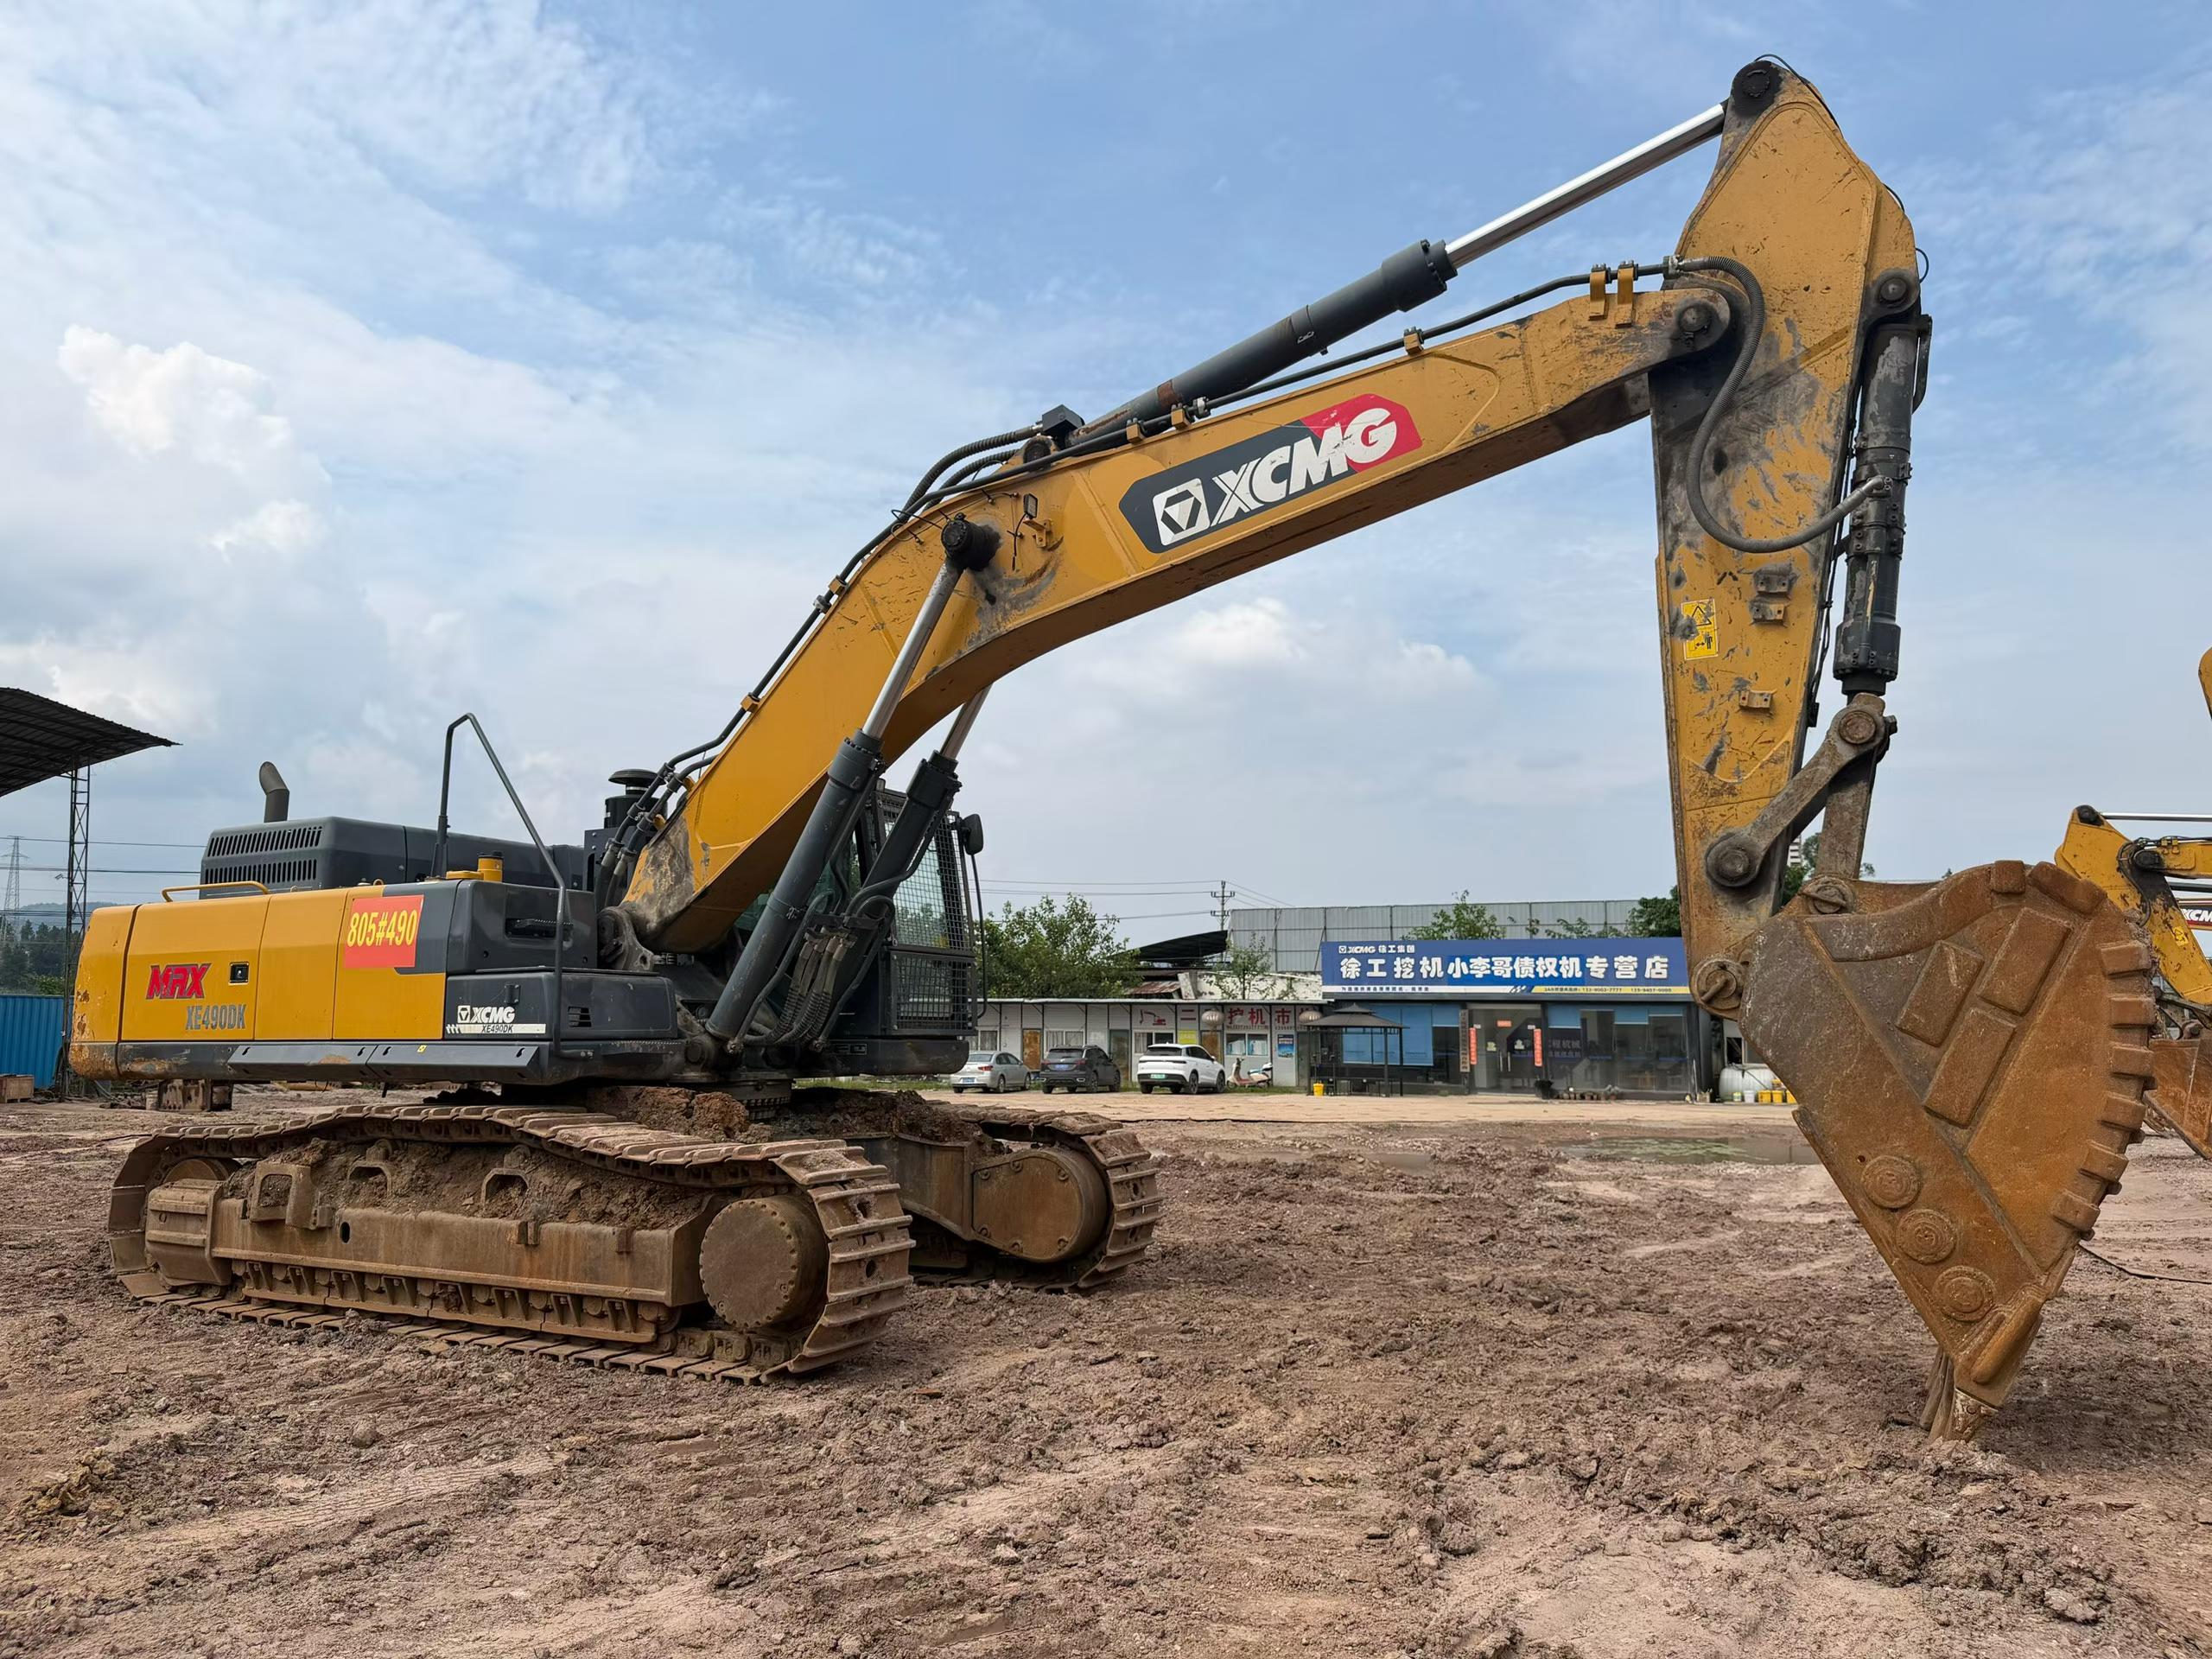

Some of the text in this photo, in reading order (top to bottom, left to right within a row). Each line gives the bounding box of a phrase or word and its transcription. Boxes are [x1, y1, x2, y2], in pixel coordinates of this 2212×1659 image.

[1210, 408, 1397, 527] XCMG
[347, 909, 418, 949] 805#490
[1348, 945, 1376, 954] XCMG
[185, 1004, 247, 1031] XE490DK
[470, 1006, 516, 1024] XCMG
[480, 1024, 514, 1033] XE490DK
